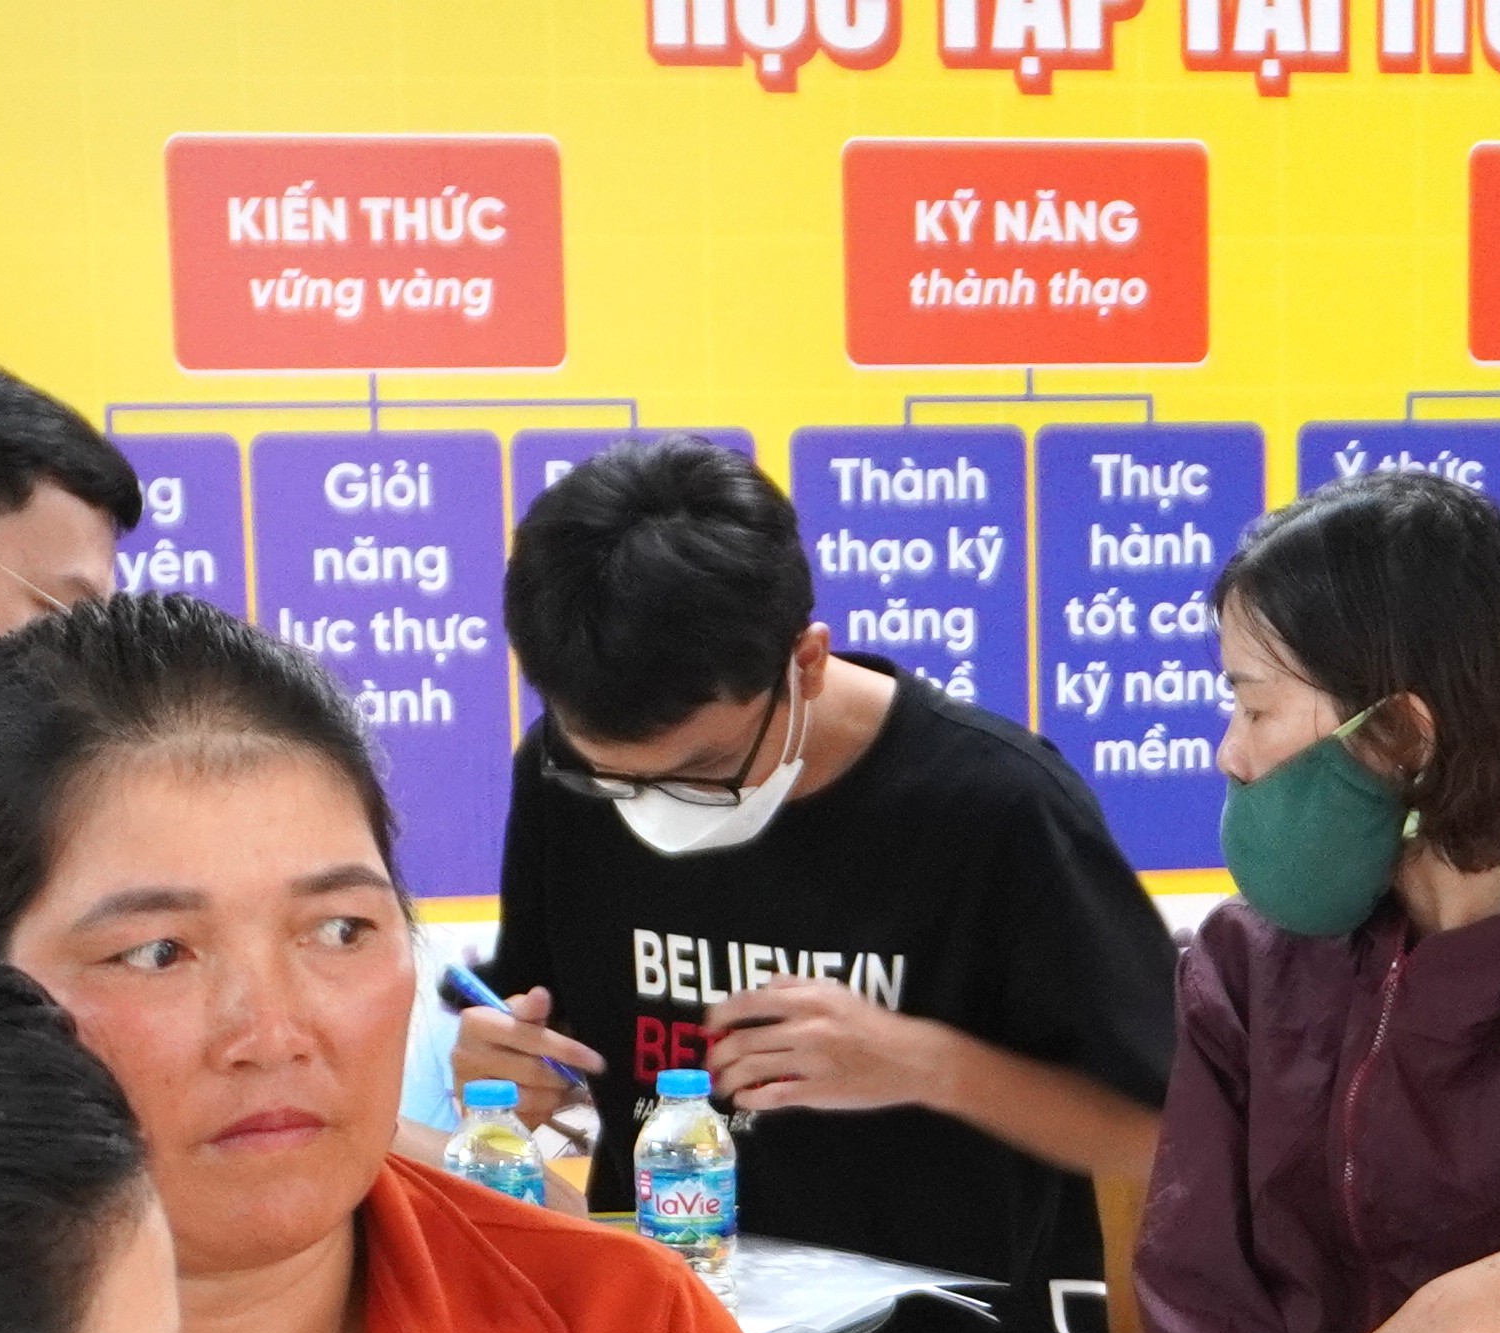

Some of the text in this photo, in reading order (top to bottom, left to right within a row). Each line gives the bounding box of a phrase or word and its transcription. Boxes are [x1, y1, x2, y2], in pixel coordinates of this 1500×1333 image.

[227, 180, 509, 243] KIẾN THỨC
[914, 195, 1139, 244] KỸ NĂNG
[249, 266, 493, 320] vững vàng
[909, 268, 1148, 321] thành thạo
[324, 461, 430, 509] Giỏi
[831, 457, 986, 502] Thành
[1091, 454, 1209, 507] Thực
[313, 536, 448, 590] năng
[816, 526, 1003, 583] thạo kỹ
[1090, 522, 1211, 567] hành
[371, 608, 488, 664] thực
[849, 599, 974, 651] năng
[1065, 588, 1212, 635] tốt cá
[359, 679, 452, 722] ành
[1056, 661, 1236, 715] kỹ năng
[1094, 724, 1210, 771] mềm
[655, 1191, 721, 1215] laVie
